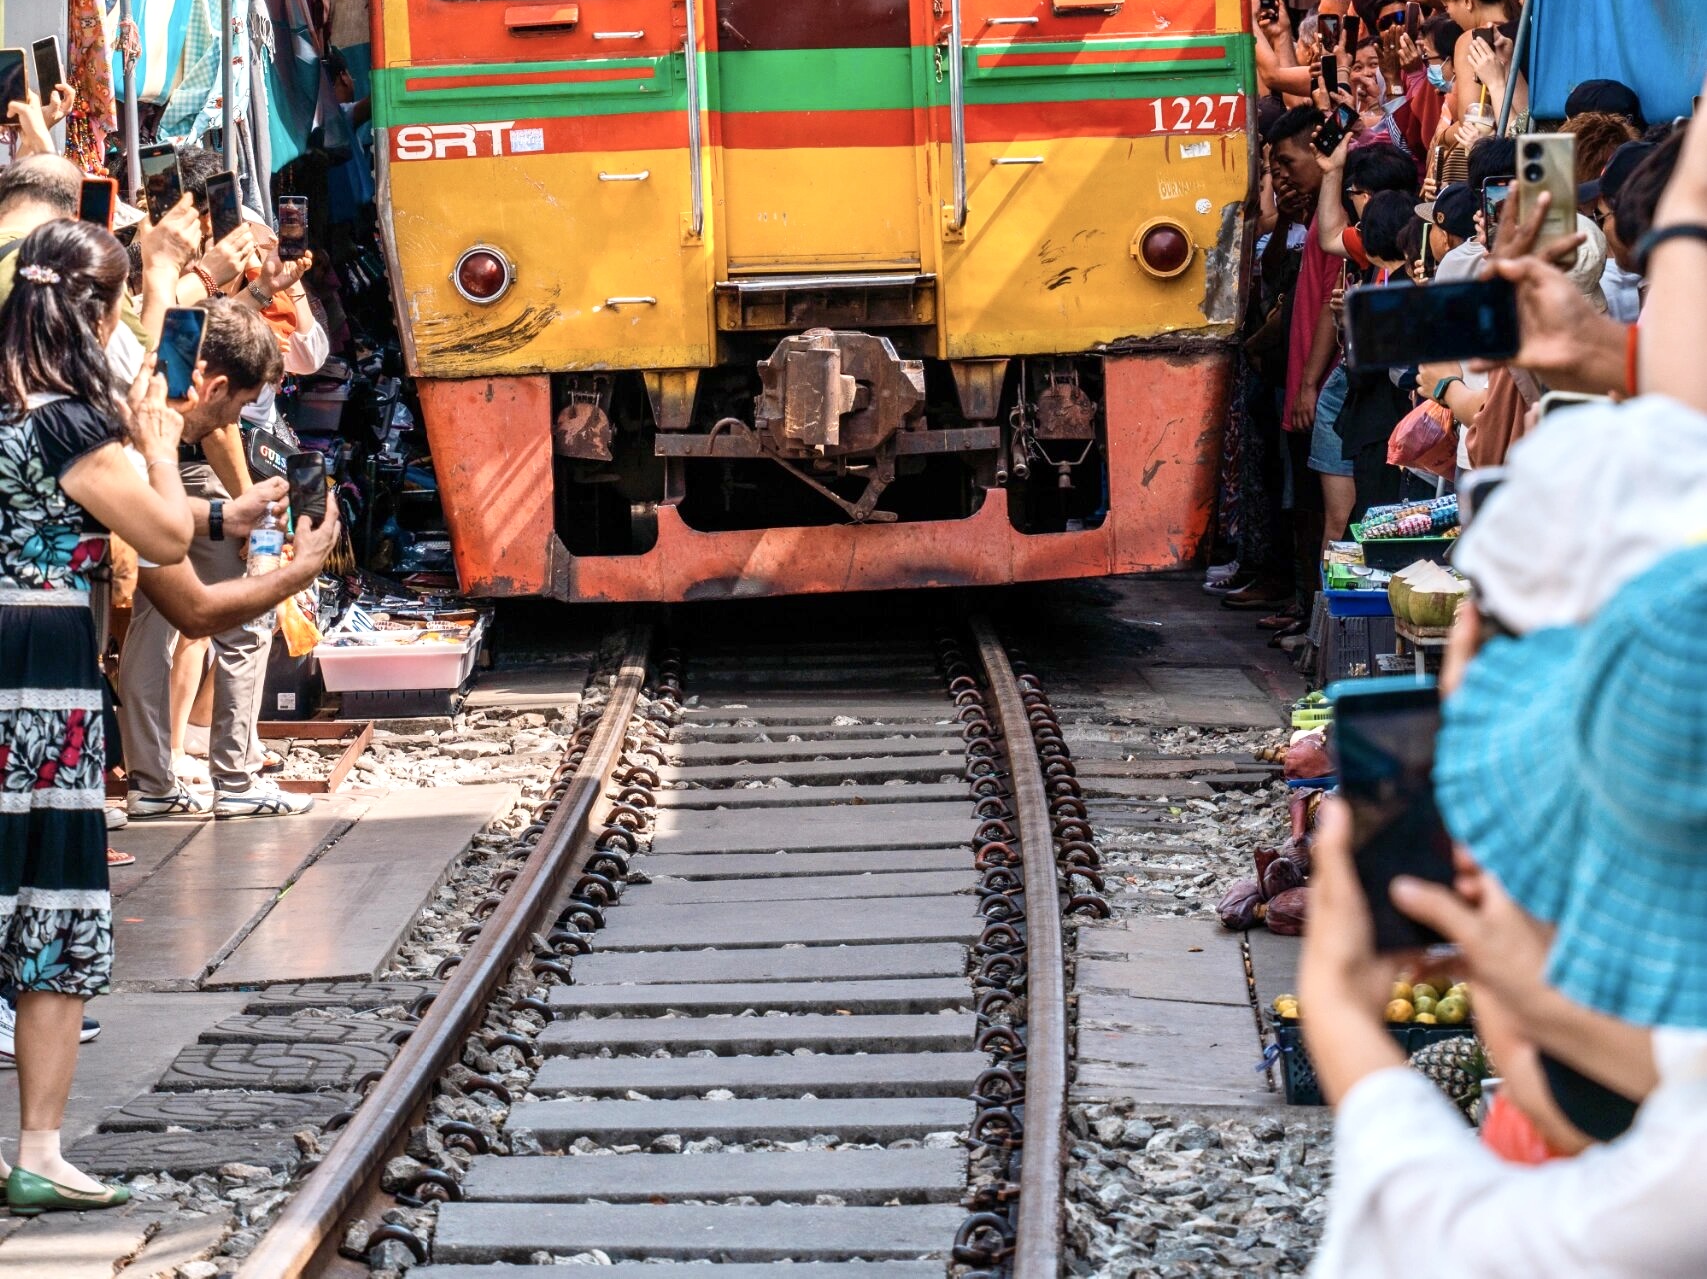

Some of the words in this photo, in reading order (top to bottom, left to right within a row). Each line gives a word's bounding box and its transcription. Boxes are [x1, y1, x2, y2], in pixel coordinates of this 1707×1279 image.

[1148, 95, 1240, 132] 1227
[396, 120, 516, 160] SRT
[259, 445, 288, 470] GUES
